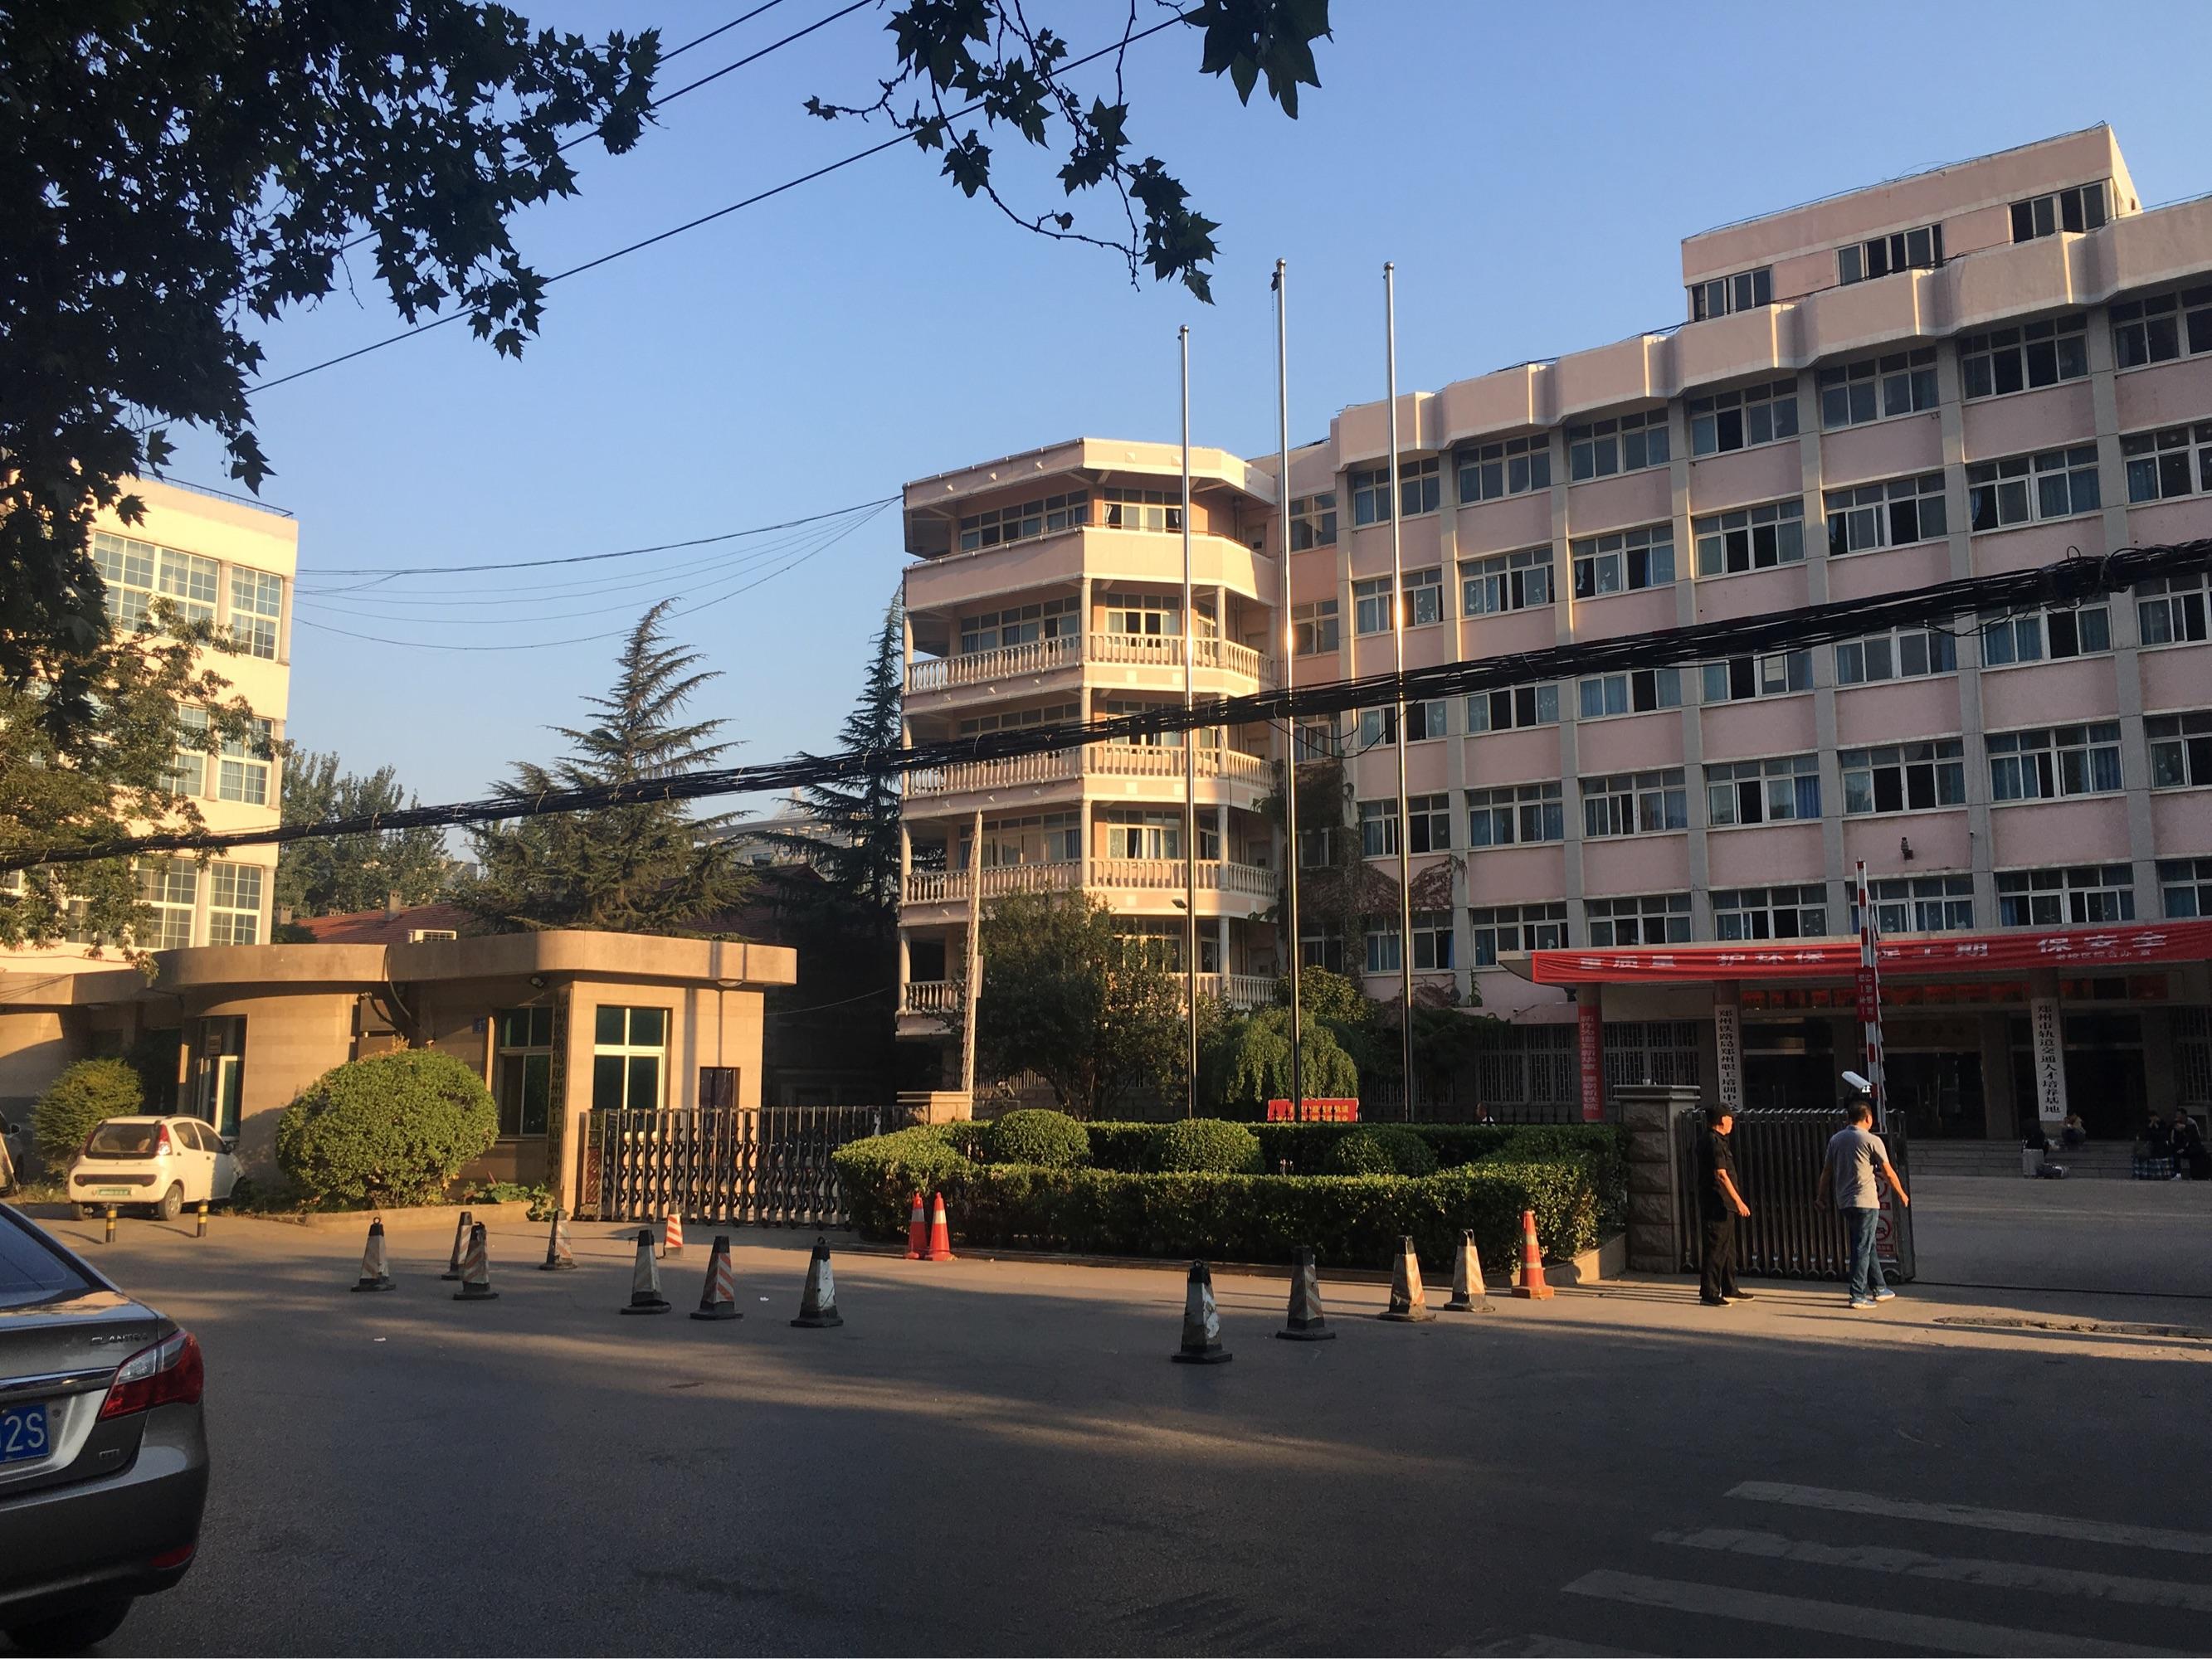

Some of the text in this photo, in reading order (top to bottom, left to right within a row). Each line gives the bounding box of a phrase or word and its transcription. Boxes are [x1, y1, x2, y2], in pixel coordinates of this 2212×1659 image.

[1716, 949, 1825, 967] 护环保
[2036, 931, 2168, 953] 保安全
[546, 994, 568, 1184] 州铁路局郑州职工培训中心
[2037, 1005, 2061, 1113] 郑州市轨道交通人才培养基地
[0, 1413, 45, 1452] 2S
